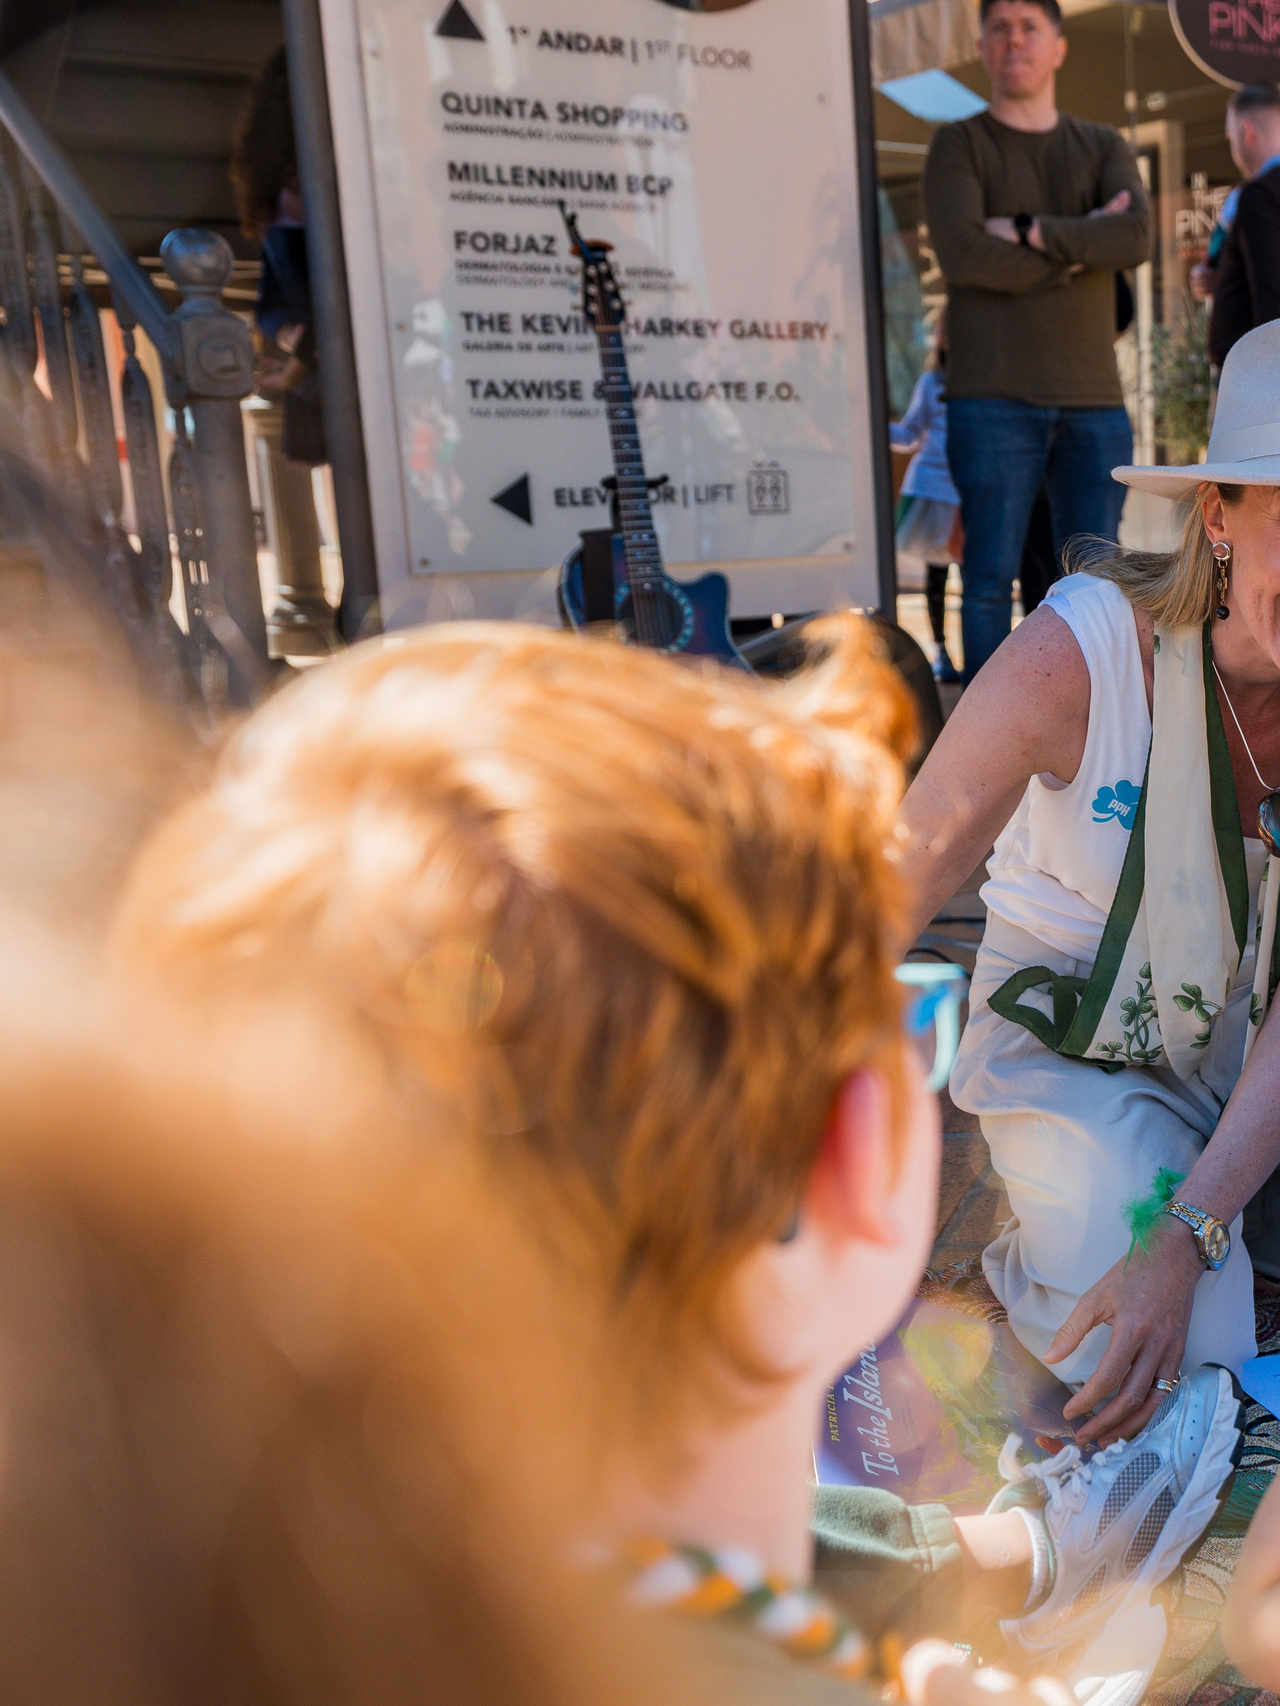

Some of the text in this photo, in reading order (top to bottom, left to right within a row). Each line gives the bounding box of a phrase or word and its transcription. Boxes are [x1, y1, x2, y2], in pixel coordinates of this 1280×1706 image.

[537, 29, 626, 57] ANDAR
[676, 43, 753, 70] FLOOR
[441, 92, 689, 133] QUINTA SHOPPING
[448, 161, 673, 196] MILLENNIUM BCP
[454, 230, 558, 256] FORJAZ
[460, 311, 511, 334] THE
[623, 316, 720, 339] HARKEY
[729, 319, 829, 342] GALLERY
[466, 378, 582, 402] TAXWISE
[755, 381, 802, 402] F.O.
[554, 486, 677, 508] ELEVOR
[694, 484, 736, 504] LIFT
[1107, 798, 1131, 818] PPH
[826, 1392, 840, 1442] PATRICIA
[857, 1414, 892, 1449] the
[861, 1450, 900, 1477] To
